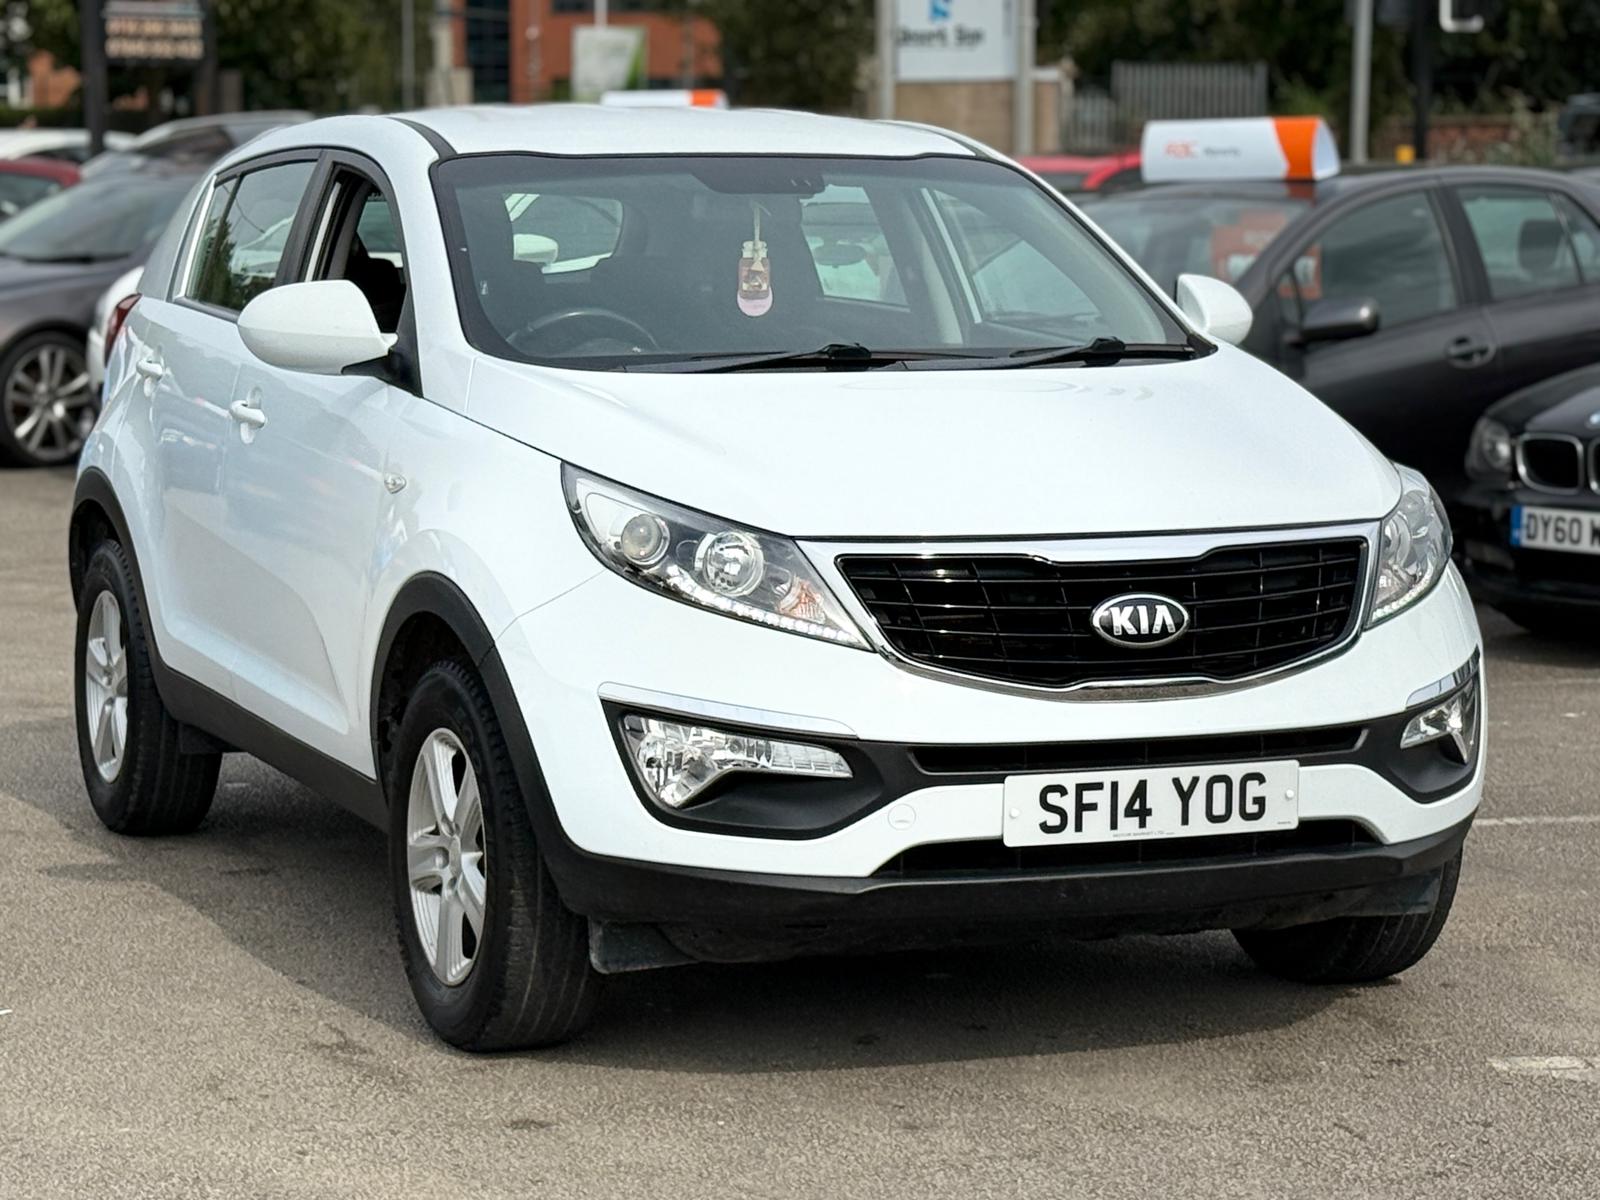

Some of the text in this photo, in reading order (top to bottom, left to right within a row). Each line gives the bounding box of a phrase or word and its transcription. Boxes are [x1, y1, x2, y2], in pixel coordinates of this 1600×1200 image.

[1526, 512, 1582, 545] DY60
[1109, 604, 1176, 636] KIA
[1038, 771, 1267, 835] SF14 YOG
